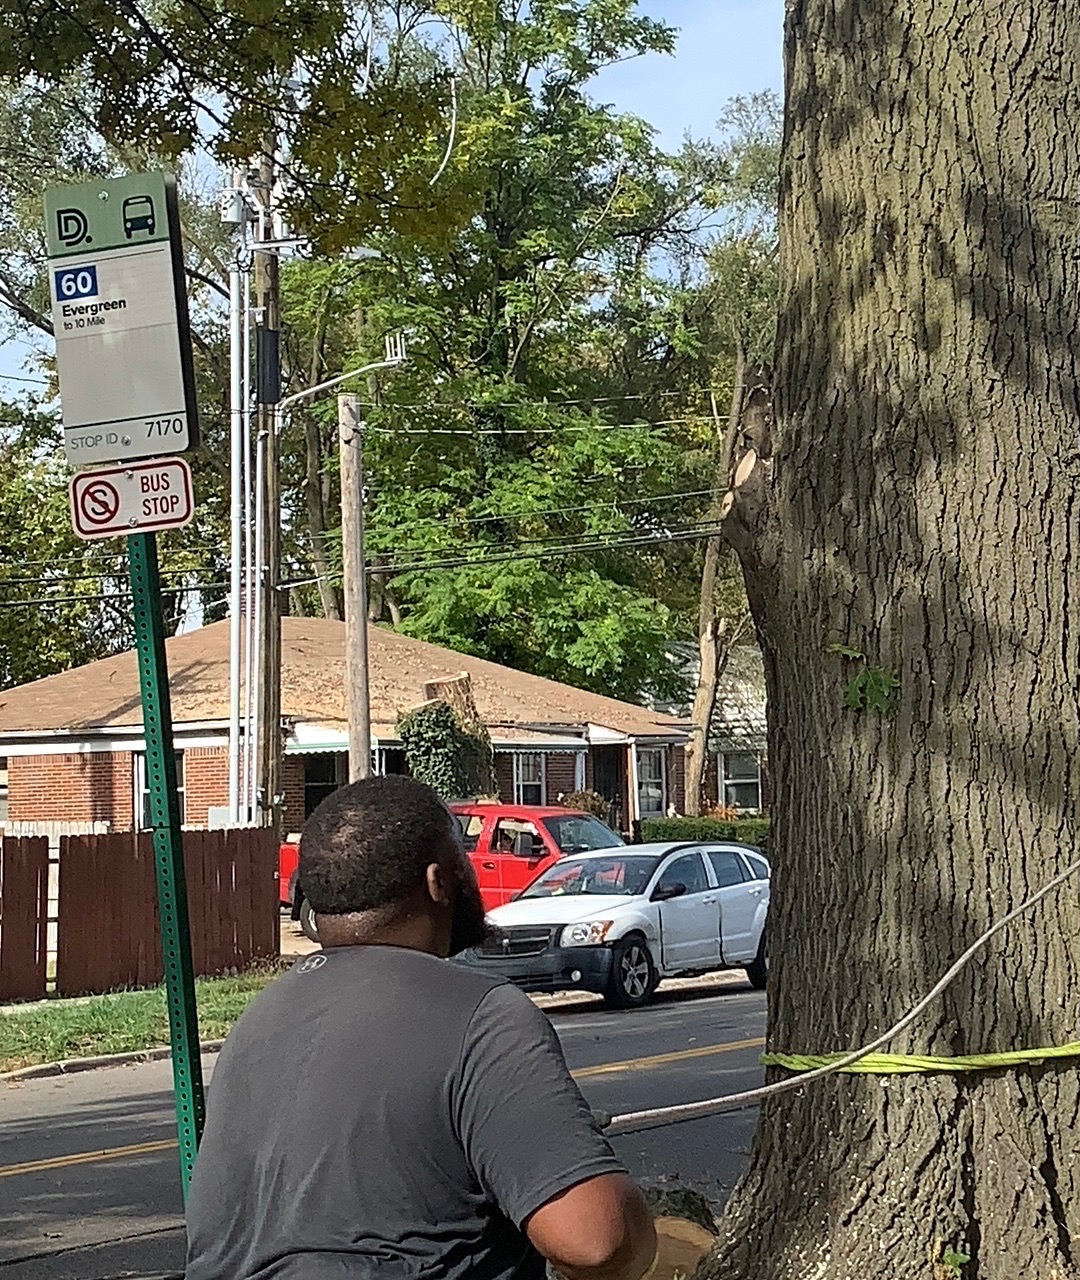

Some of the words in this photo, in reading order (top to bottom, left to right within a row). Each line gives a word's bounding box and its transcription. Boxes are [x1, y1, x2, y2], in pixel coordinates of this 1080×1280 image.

[61, 271, 92, 296] 60
[62, 299, 127, 317] Evergreen
[64, 320, 73, 331] to
[75, 318, 86, 329] 10
[86, 316, 106, 327] Mile
[71, 434, 103, 450] STOP
[105, 432, 118, 445] ID
[144, 418, 183, 438] 7170
[140, 473, 170, 493] BUS
[142, 495, 180, 516] STOP
